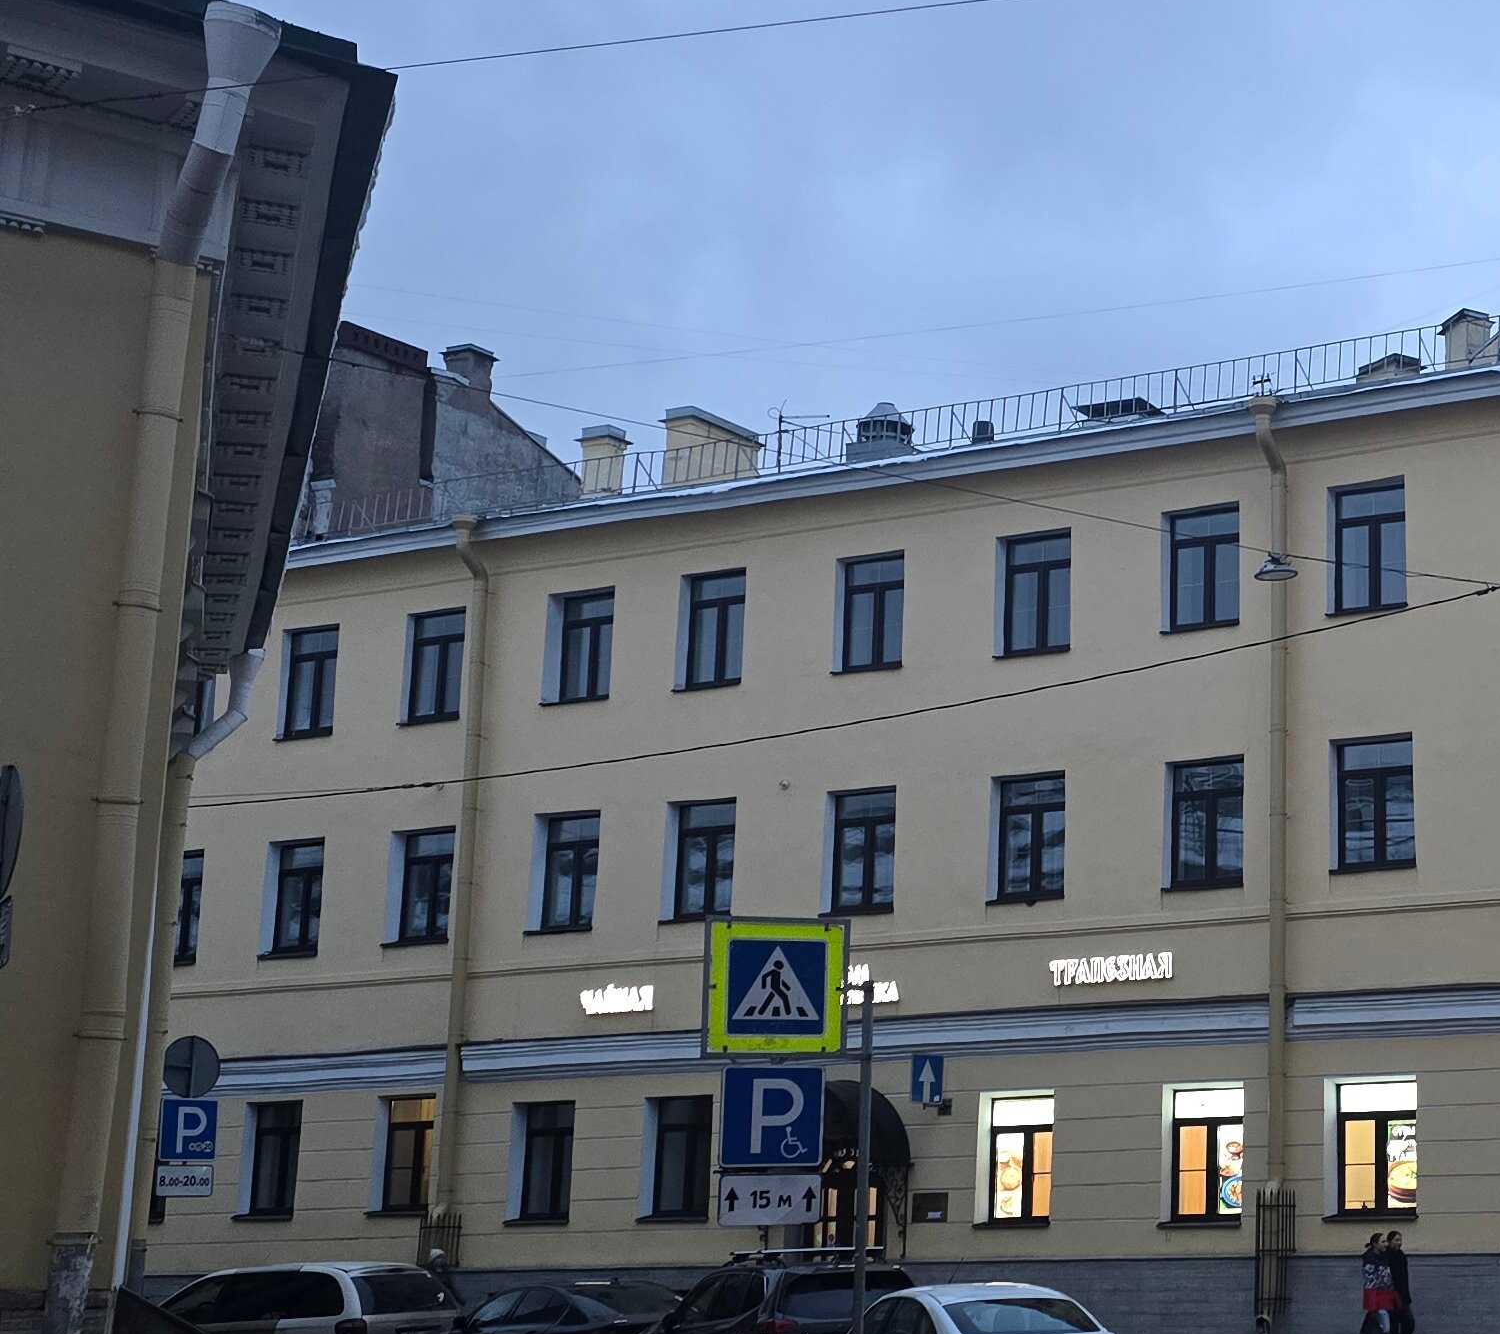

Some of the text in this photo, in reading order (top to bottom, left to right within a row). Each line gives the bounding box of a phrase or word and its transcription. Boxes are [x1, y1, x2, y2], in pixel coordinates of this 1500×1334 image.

[176, 1106, 208, 1154] P
[750, 1078, 805, 1154] P
[159, 1175, 210, 1187] 8.00-20.00
[750, 1190, 771, 1209] 15
